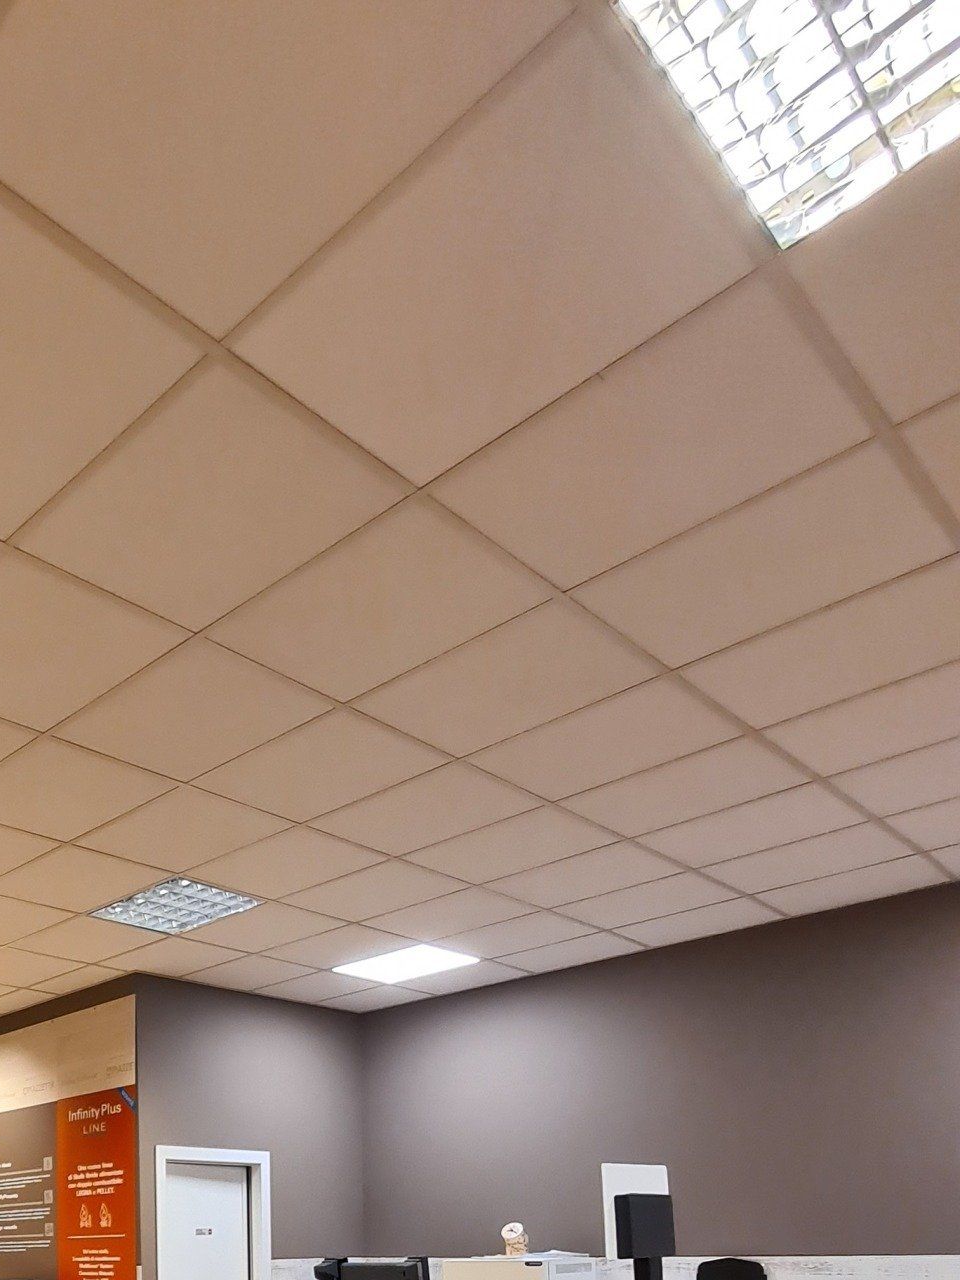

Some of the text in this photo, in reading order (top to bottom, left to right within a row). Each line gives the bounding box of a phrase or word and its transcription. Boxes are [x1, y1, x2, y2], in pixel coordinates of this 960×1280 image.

[68, 1103, 122, 1122] Infinity Plus
[82, 1122, 107, 1135] LINE
